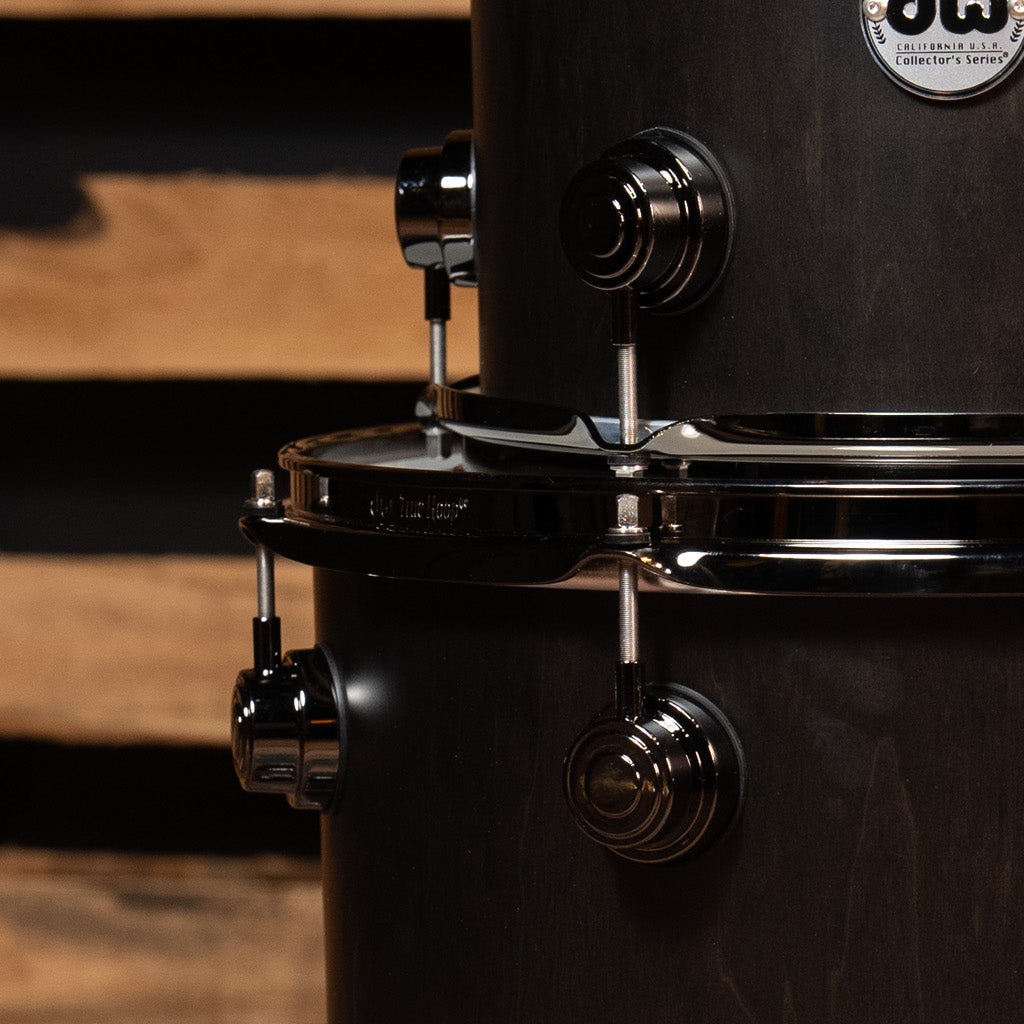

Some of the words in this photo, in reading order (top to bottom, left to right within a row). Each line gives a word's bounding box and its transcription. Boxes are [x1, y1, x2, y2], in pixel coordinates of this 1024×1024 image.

[897, 43, 964, 51] CALIFORNIA
[969, 42, 1003, 50] U.S.A.
[896, 56, 961, 66] Collector's
